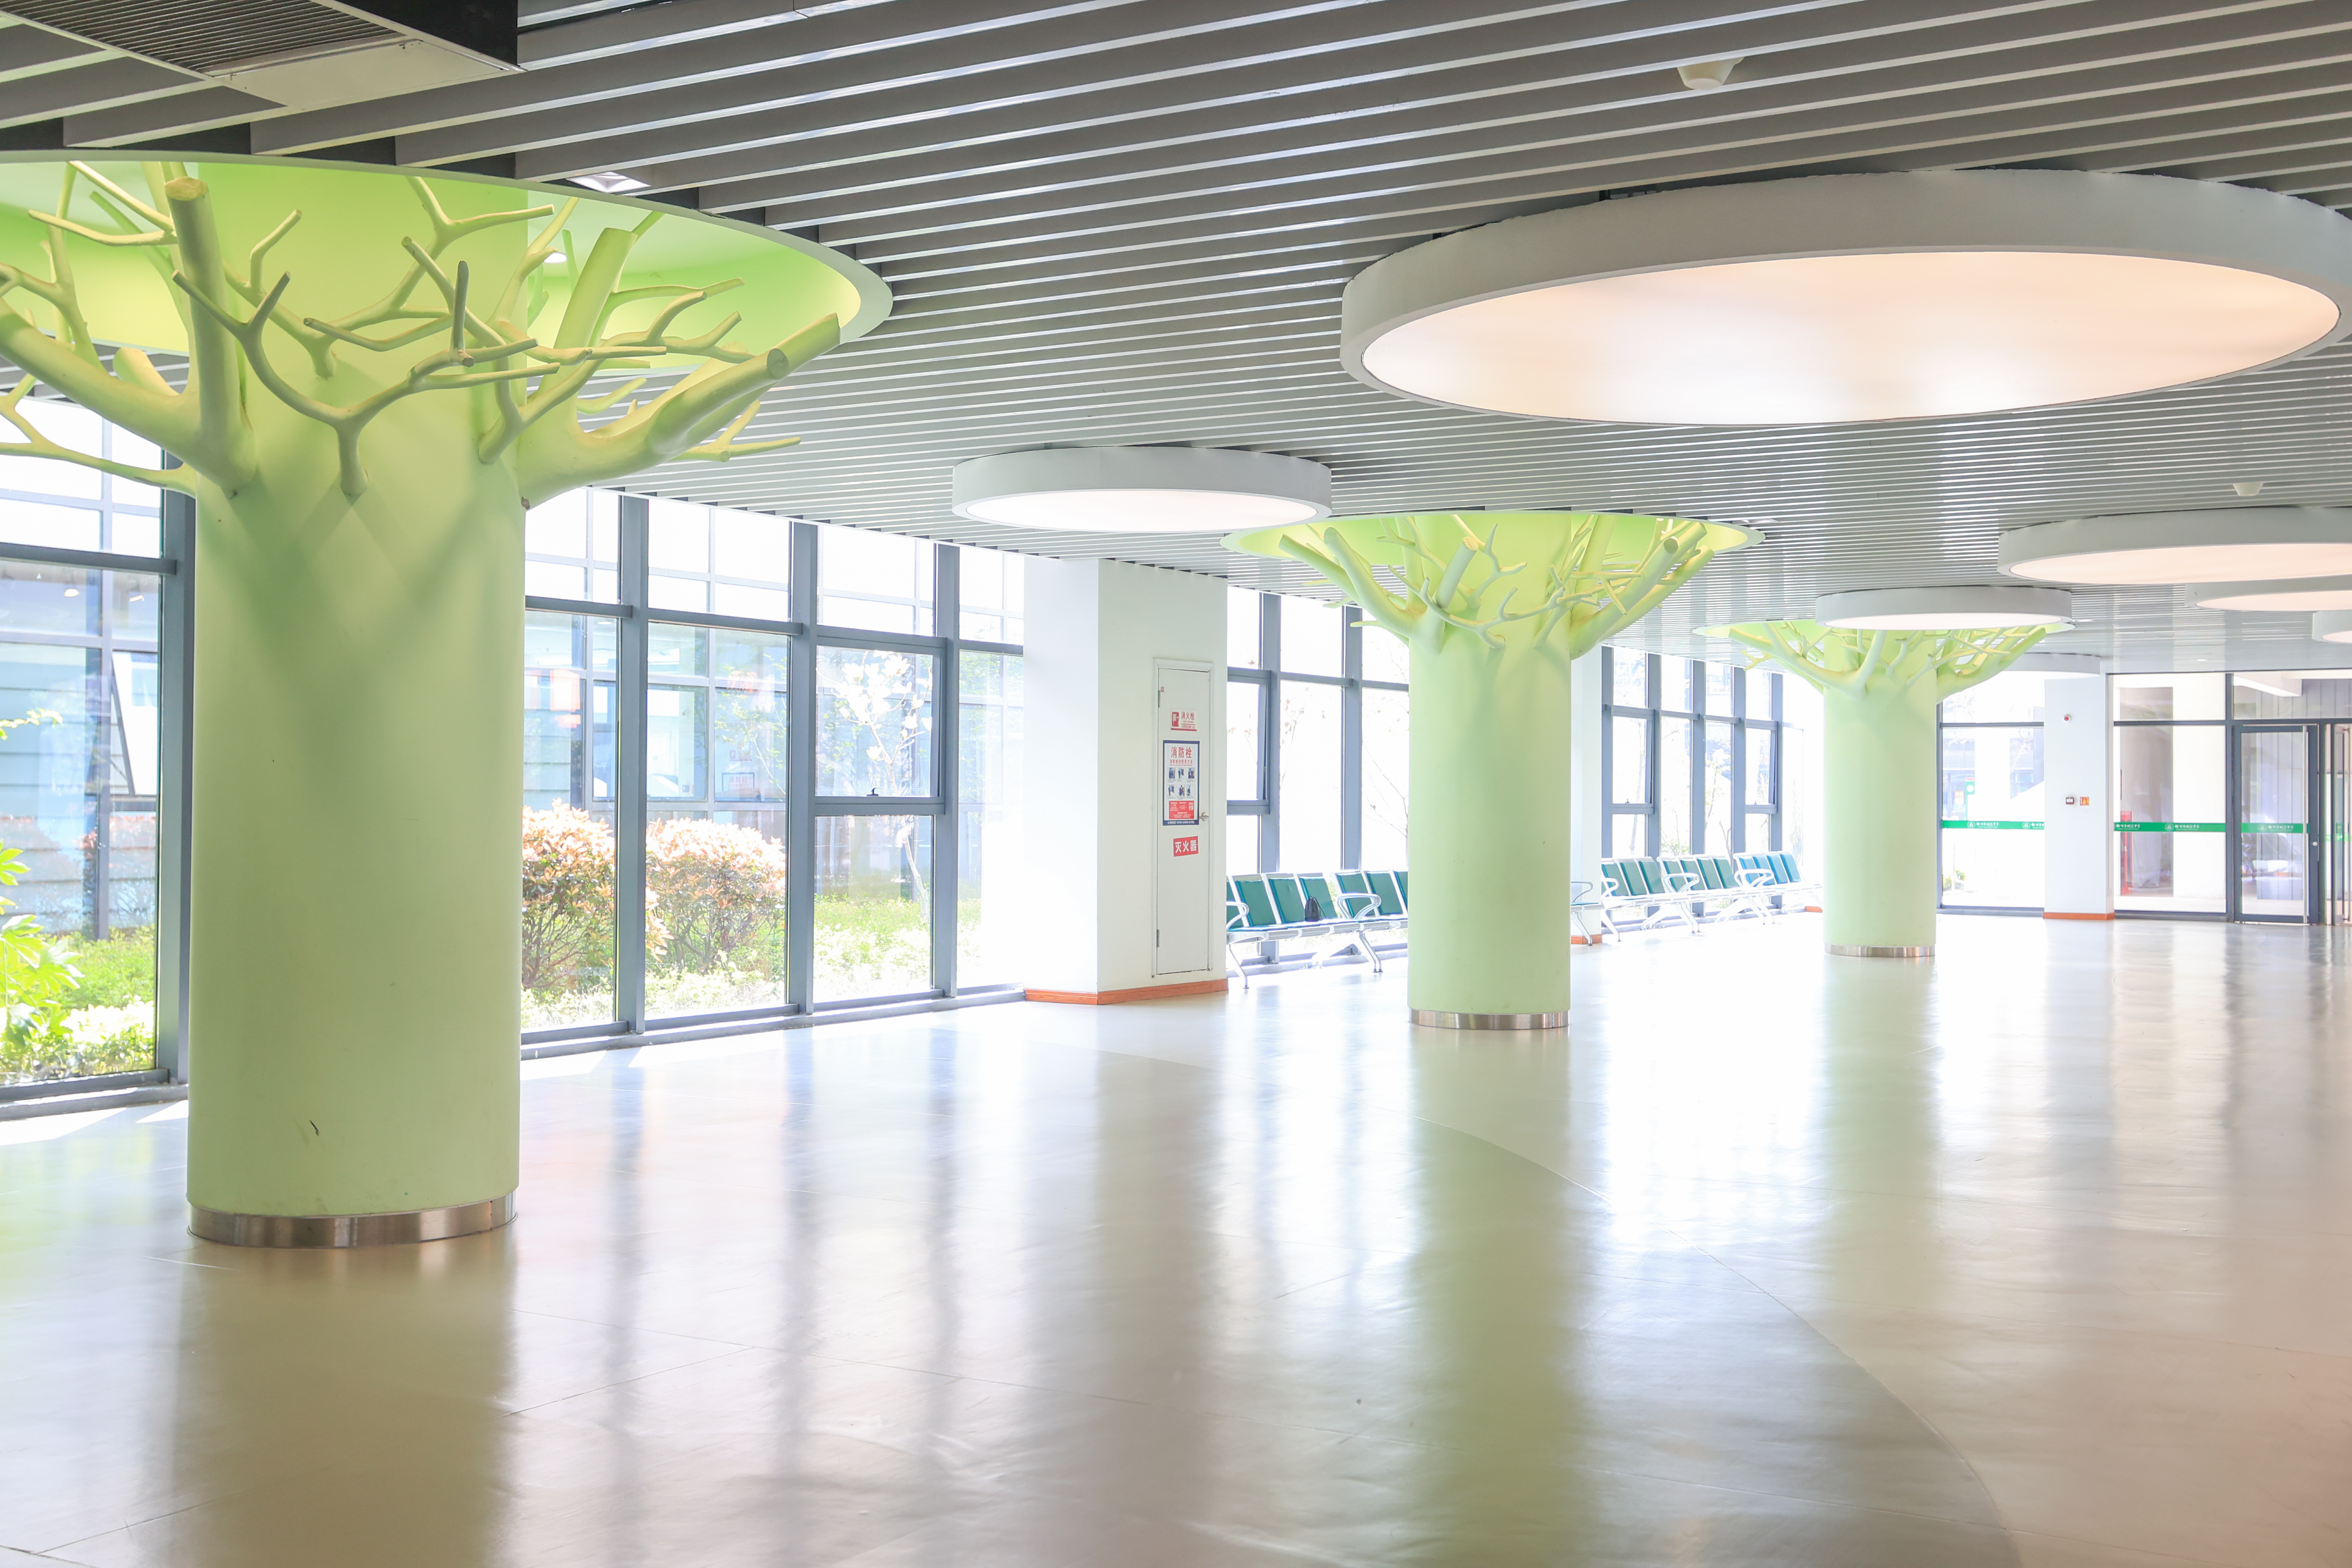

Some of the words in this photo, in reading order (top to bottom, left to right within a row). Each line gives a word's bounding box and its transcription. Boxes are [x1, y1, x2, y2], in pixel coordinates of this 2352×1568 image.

[1181, 711, 1194, 720] 消火栓
[1171, 746, 1192, 759] 消防栓
[1175, 839, 1197, 853] 灭火器
